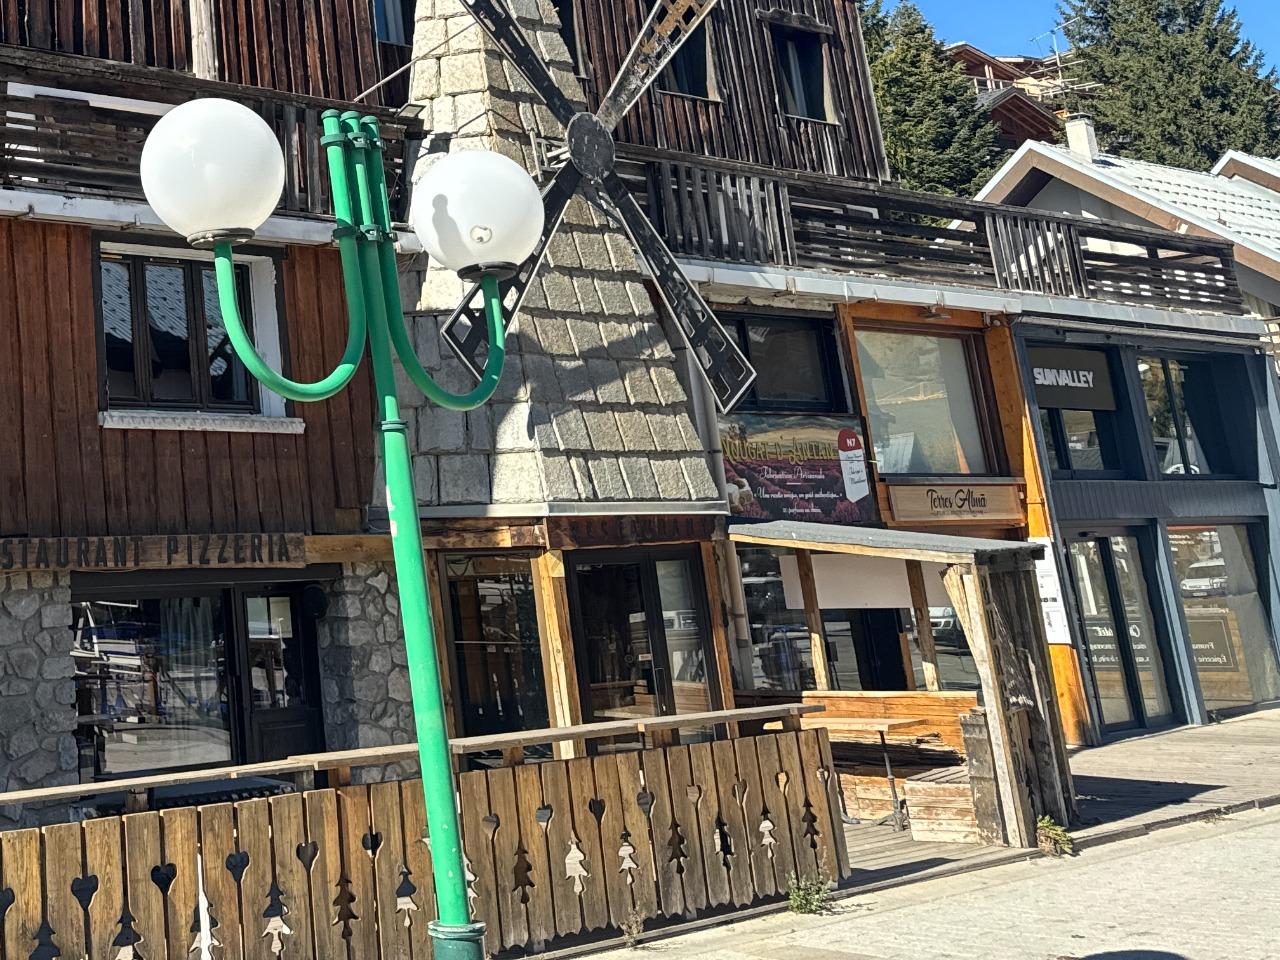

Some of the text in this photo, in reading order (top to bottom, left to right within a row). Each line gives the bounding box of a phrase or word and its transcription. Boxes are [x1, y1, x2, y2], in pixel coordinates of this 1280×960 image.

[1033, 367, 1094, 388] SUNVALLEY
[721, 438, 769, 462] NOUGAT
[846, 438, 856, 447] N7
[926, 489, 952, 510] Terres
[166, 533, 290, 566] PIZZERIA
